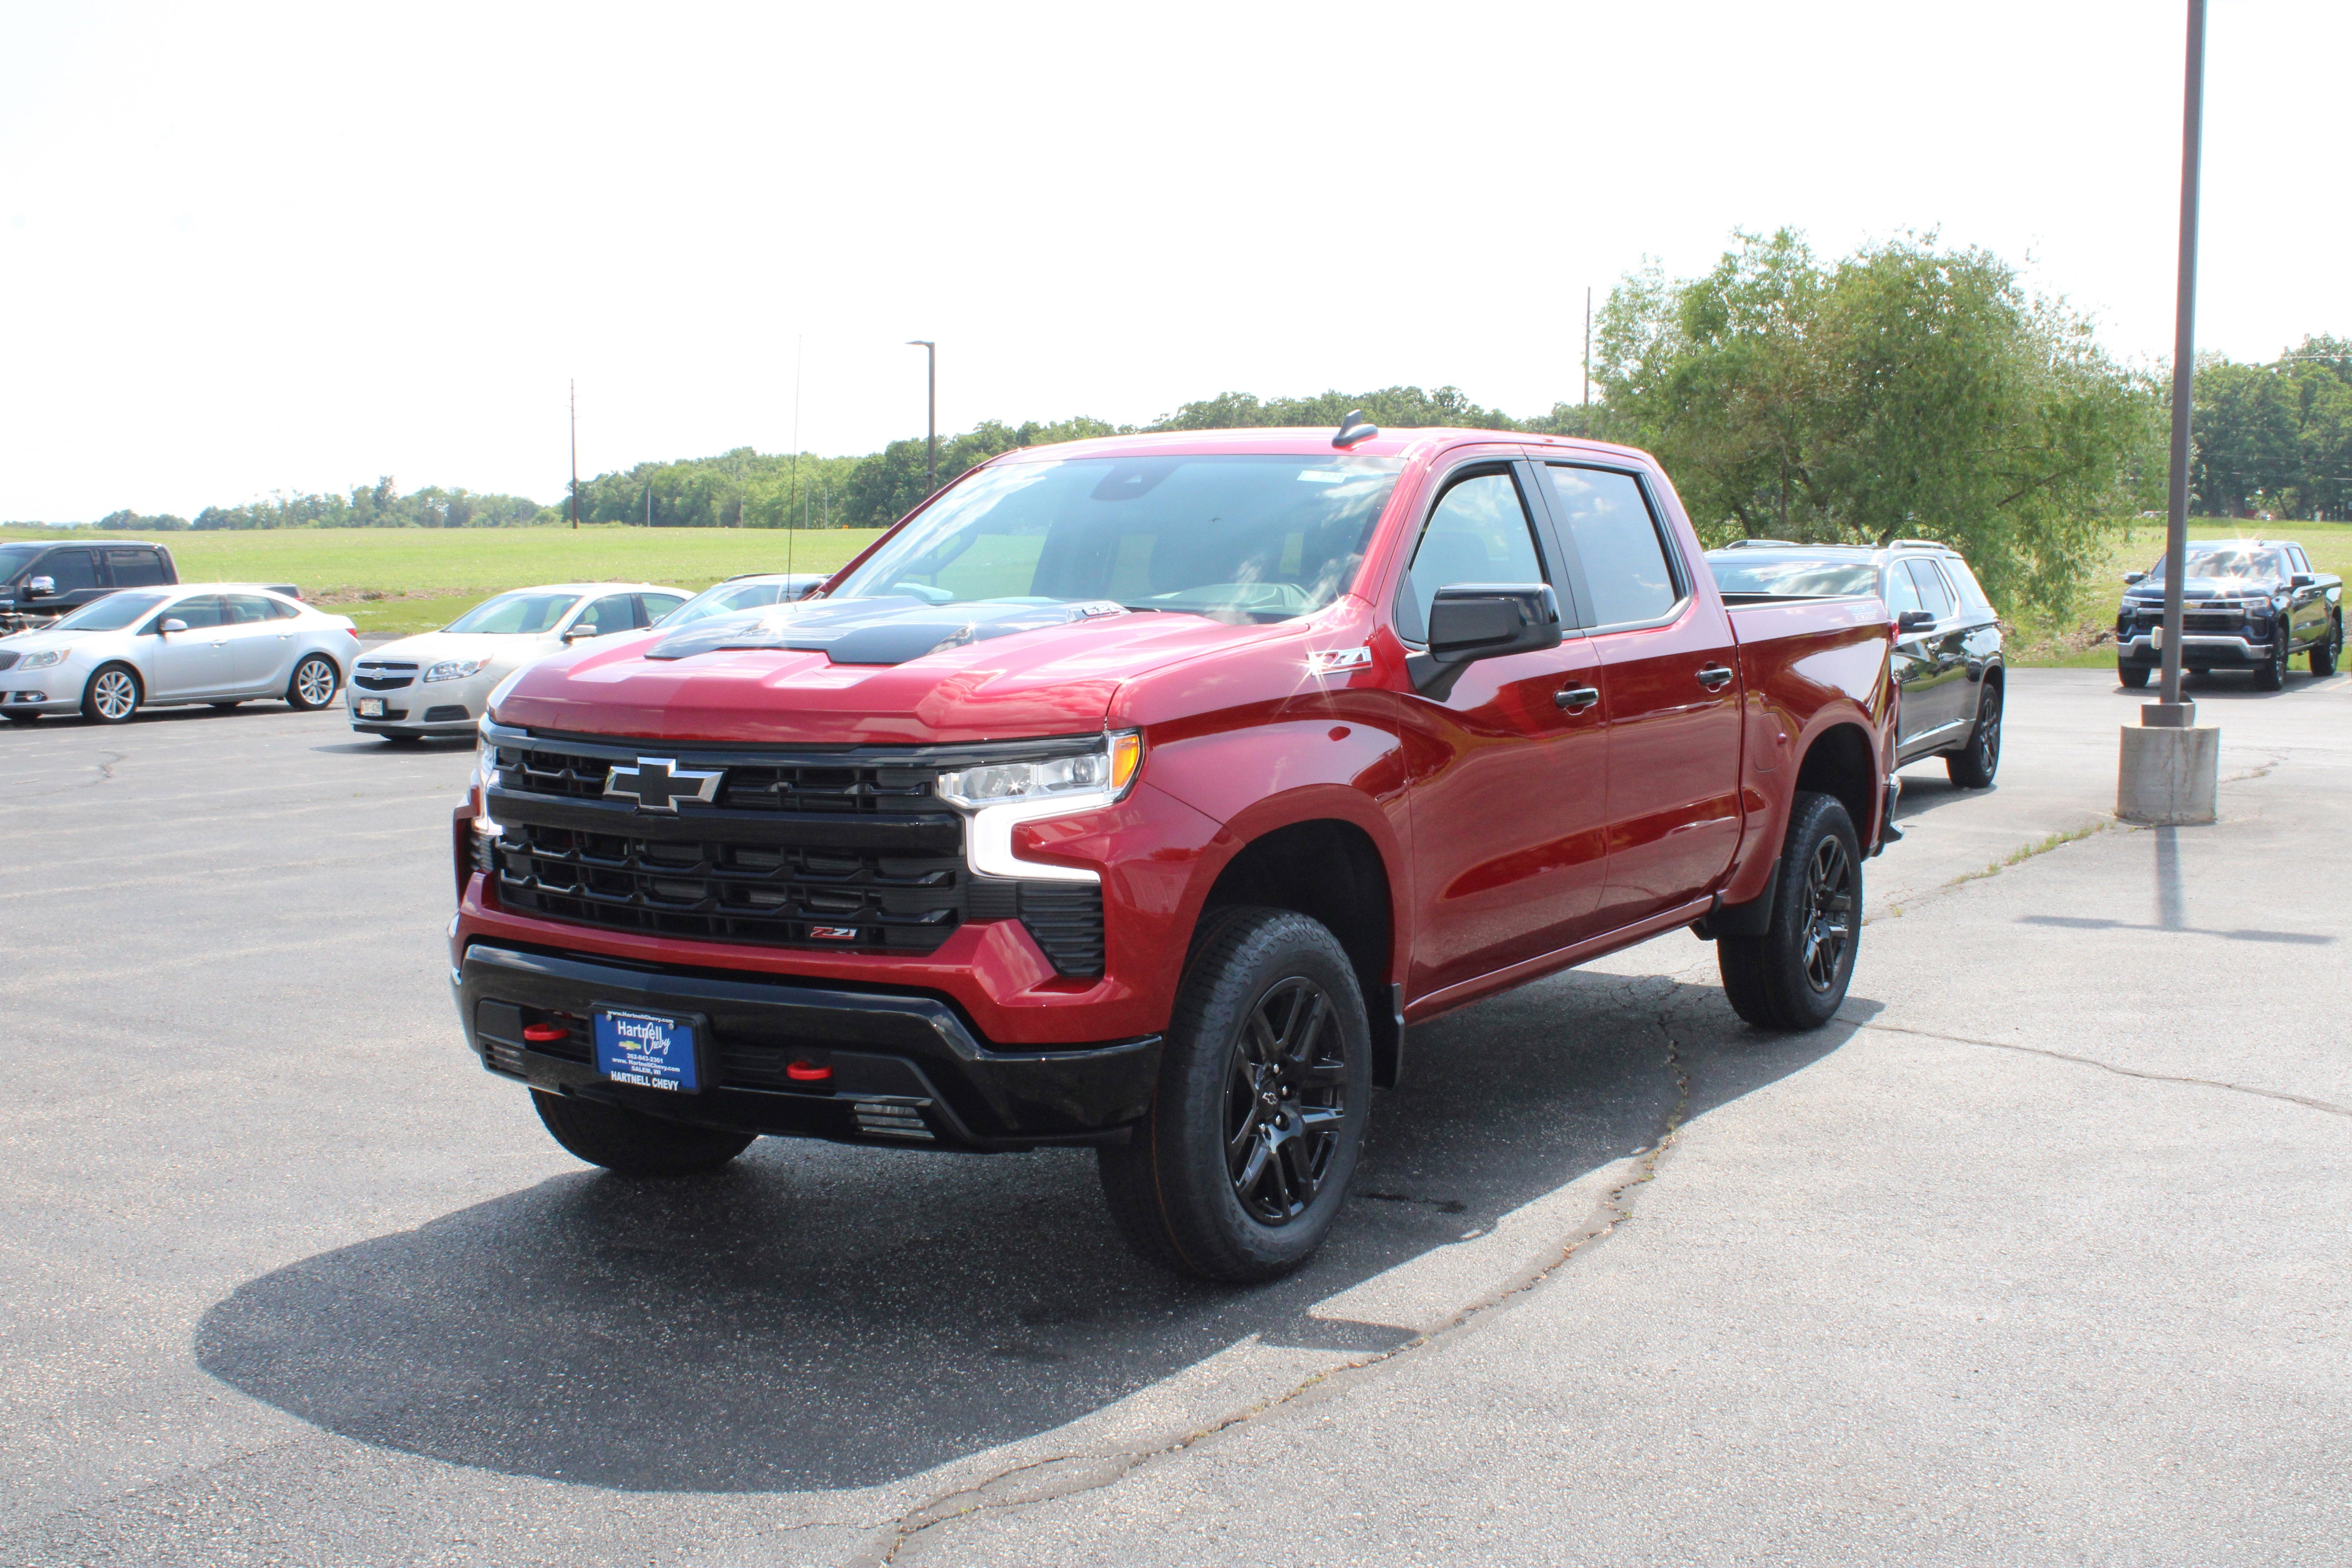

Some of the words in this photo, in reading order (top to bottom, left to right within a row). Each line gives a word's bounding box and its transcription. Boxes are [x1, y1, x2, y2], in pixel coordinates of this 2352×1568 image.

[811, 927, 858, 939] Z71
[607, 1010, 674, 1023] www.HartnellChevy.com
[617, 1020, 662, 1041] Hartnell
[644, 1022, 671, 1055] Chevy
[632, 1066, 653, 1075] SALEM,
[611, 1070, 651, 1087] HARTNELL
[652, 1077, 679, 1091] CHEVY
